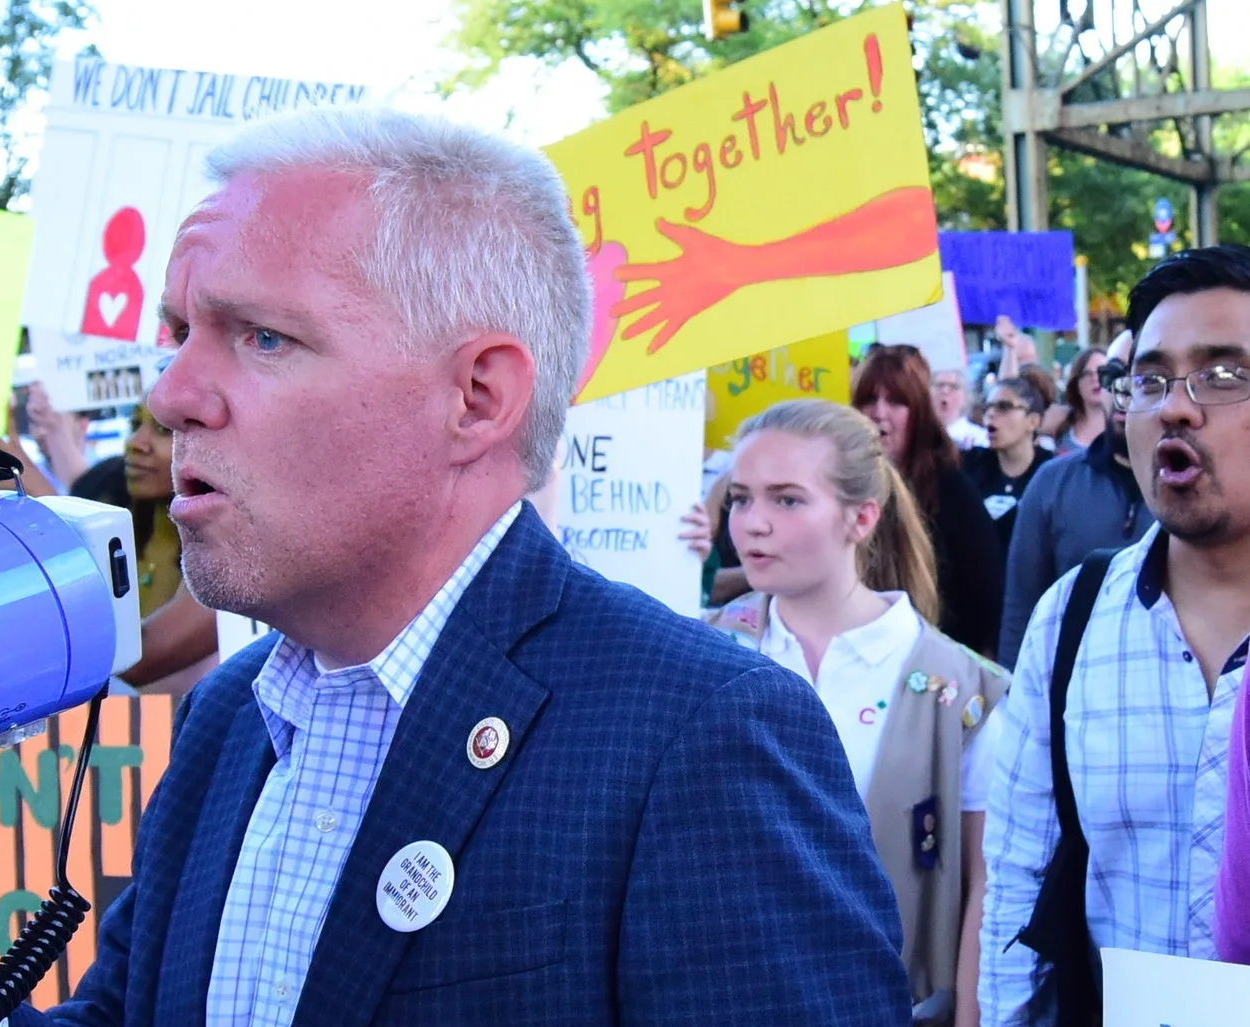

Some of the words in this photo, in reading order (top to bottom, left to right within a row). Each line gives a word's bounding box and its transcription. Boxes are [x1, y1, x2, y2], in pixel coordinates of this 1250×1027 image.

[73, 57, 108, 107] WE
[186, 71, 237, 120] JAIL
[624, 32, 884, 222] together!
[571, 474, 672, 514] BEHIND
[399, 858, 439, 902] GRANDCHILD
[418, 856, 429, 871] AM
[425, 864, 442, 883] THE
[382, 881, 419, 922] IMMIGRANT
[399, 879, 411, 892] OF
[407, 888, 420, 903] AN
